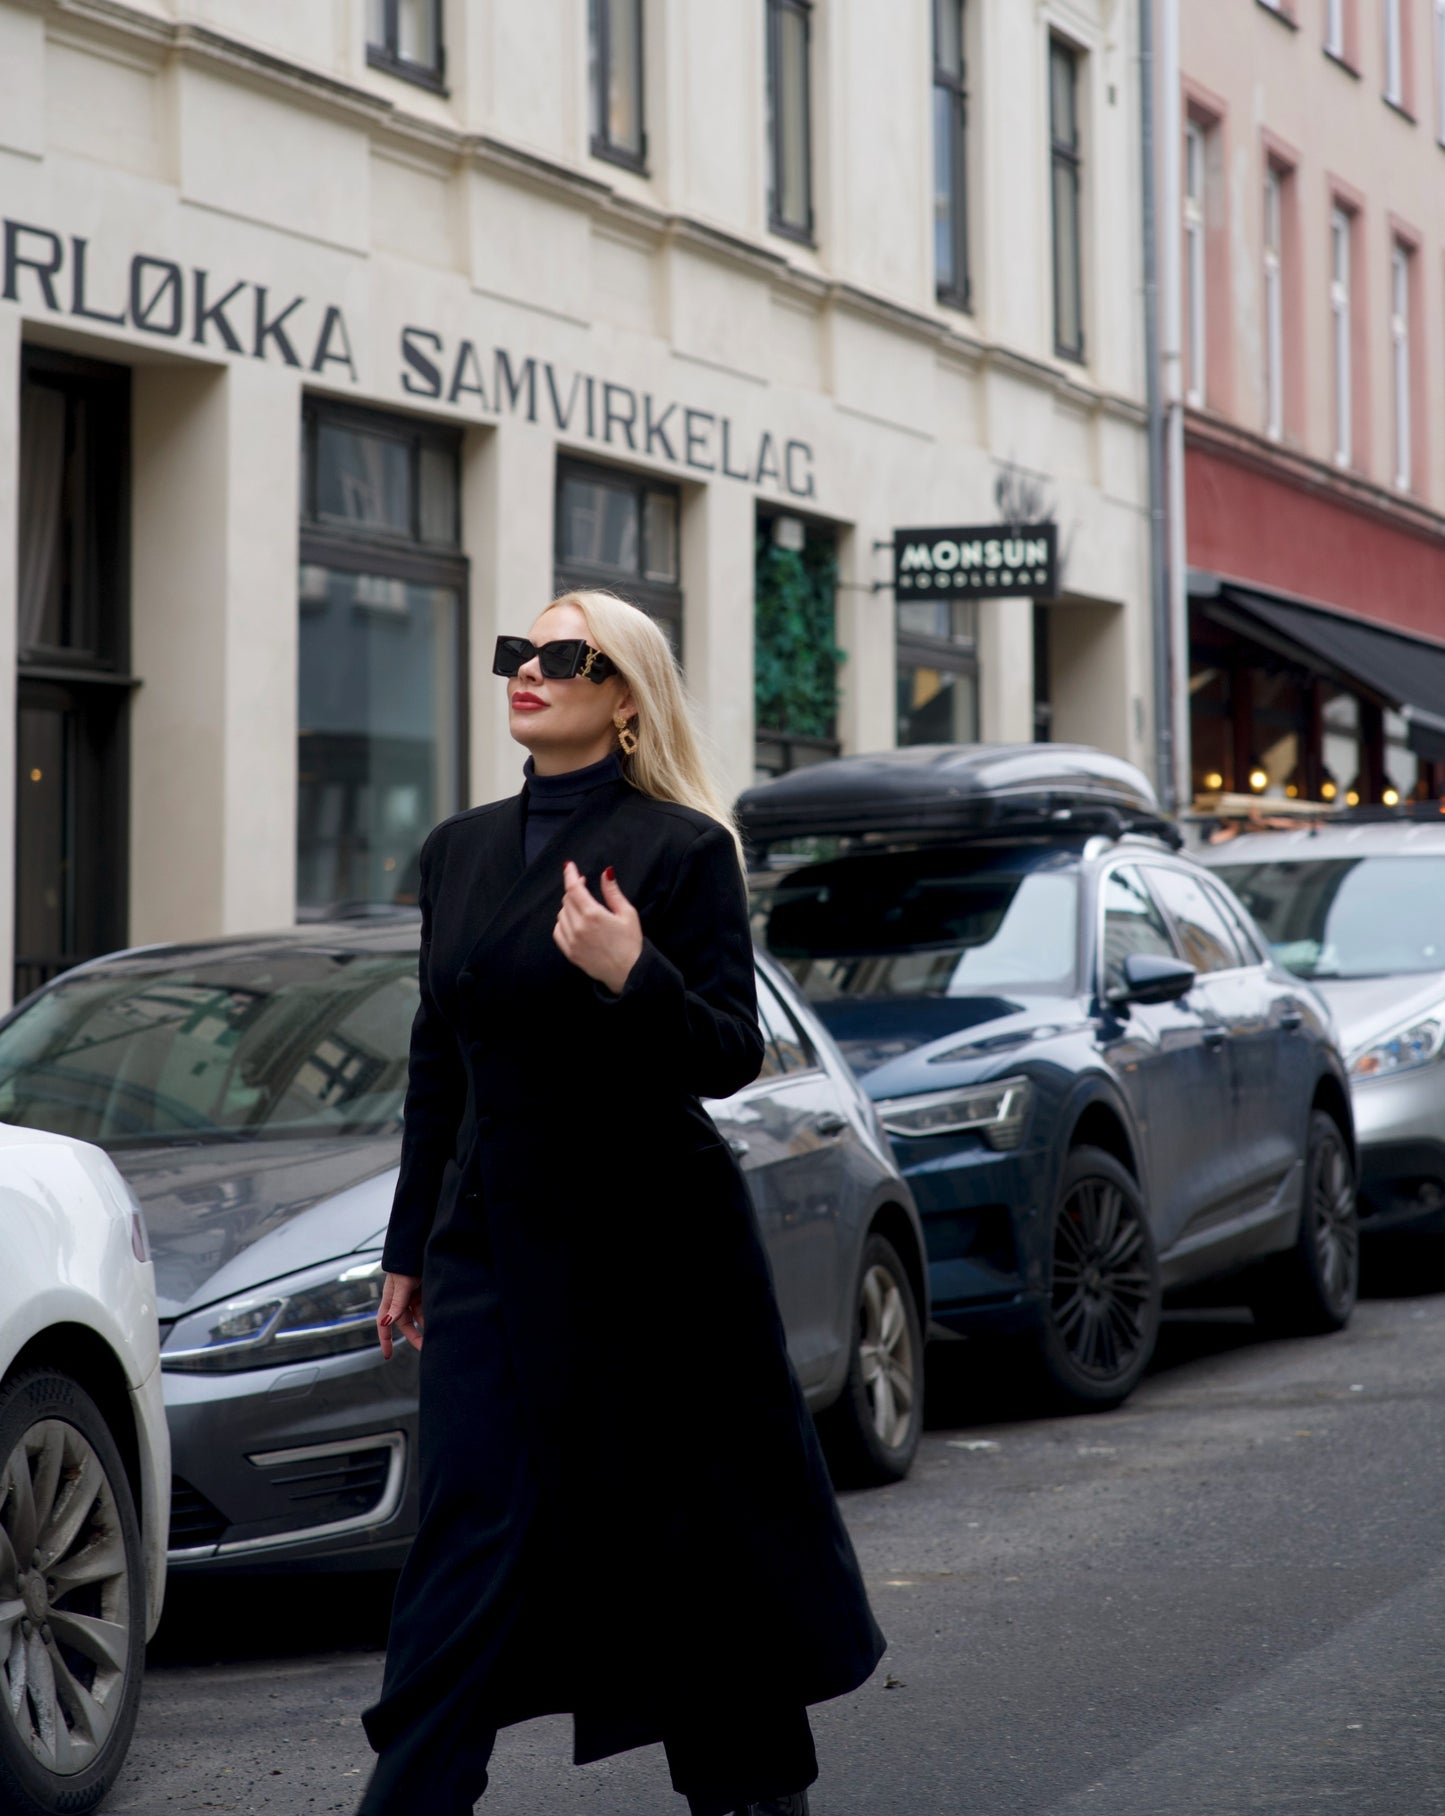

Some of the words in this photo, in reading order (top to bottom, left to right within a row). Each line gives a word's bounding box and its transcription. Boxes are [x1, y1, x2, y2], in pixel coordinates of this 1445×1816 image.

[2, 217, 359, 383] RLØKKA
[401, 325, 817, 498] SAMVIRKELAG
[900, 538, 1048, 571] MONSUN
